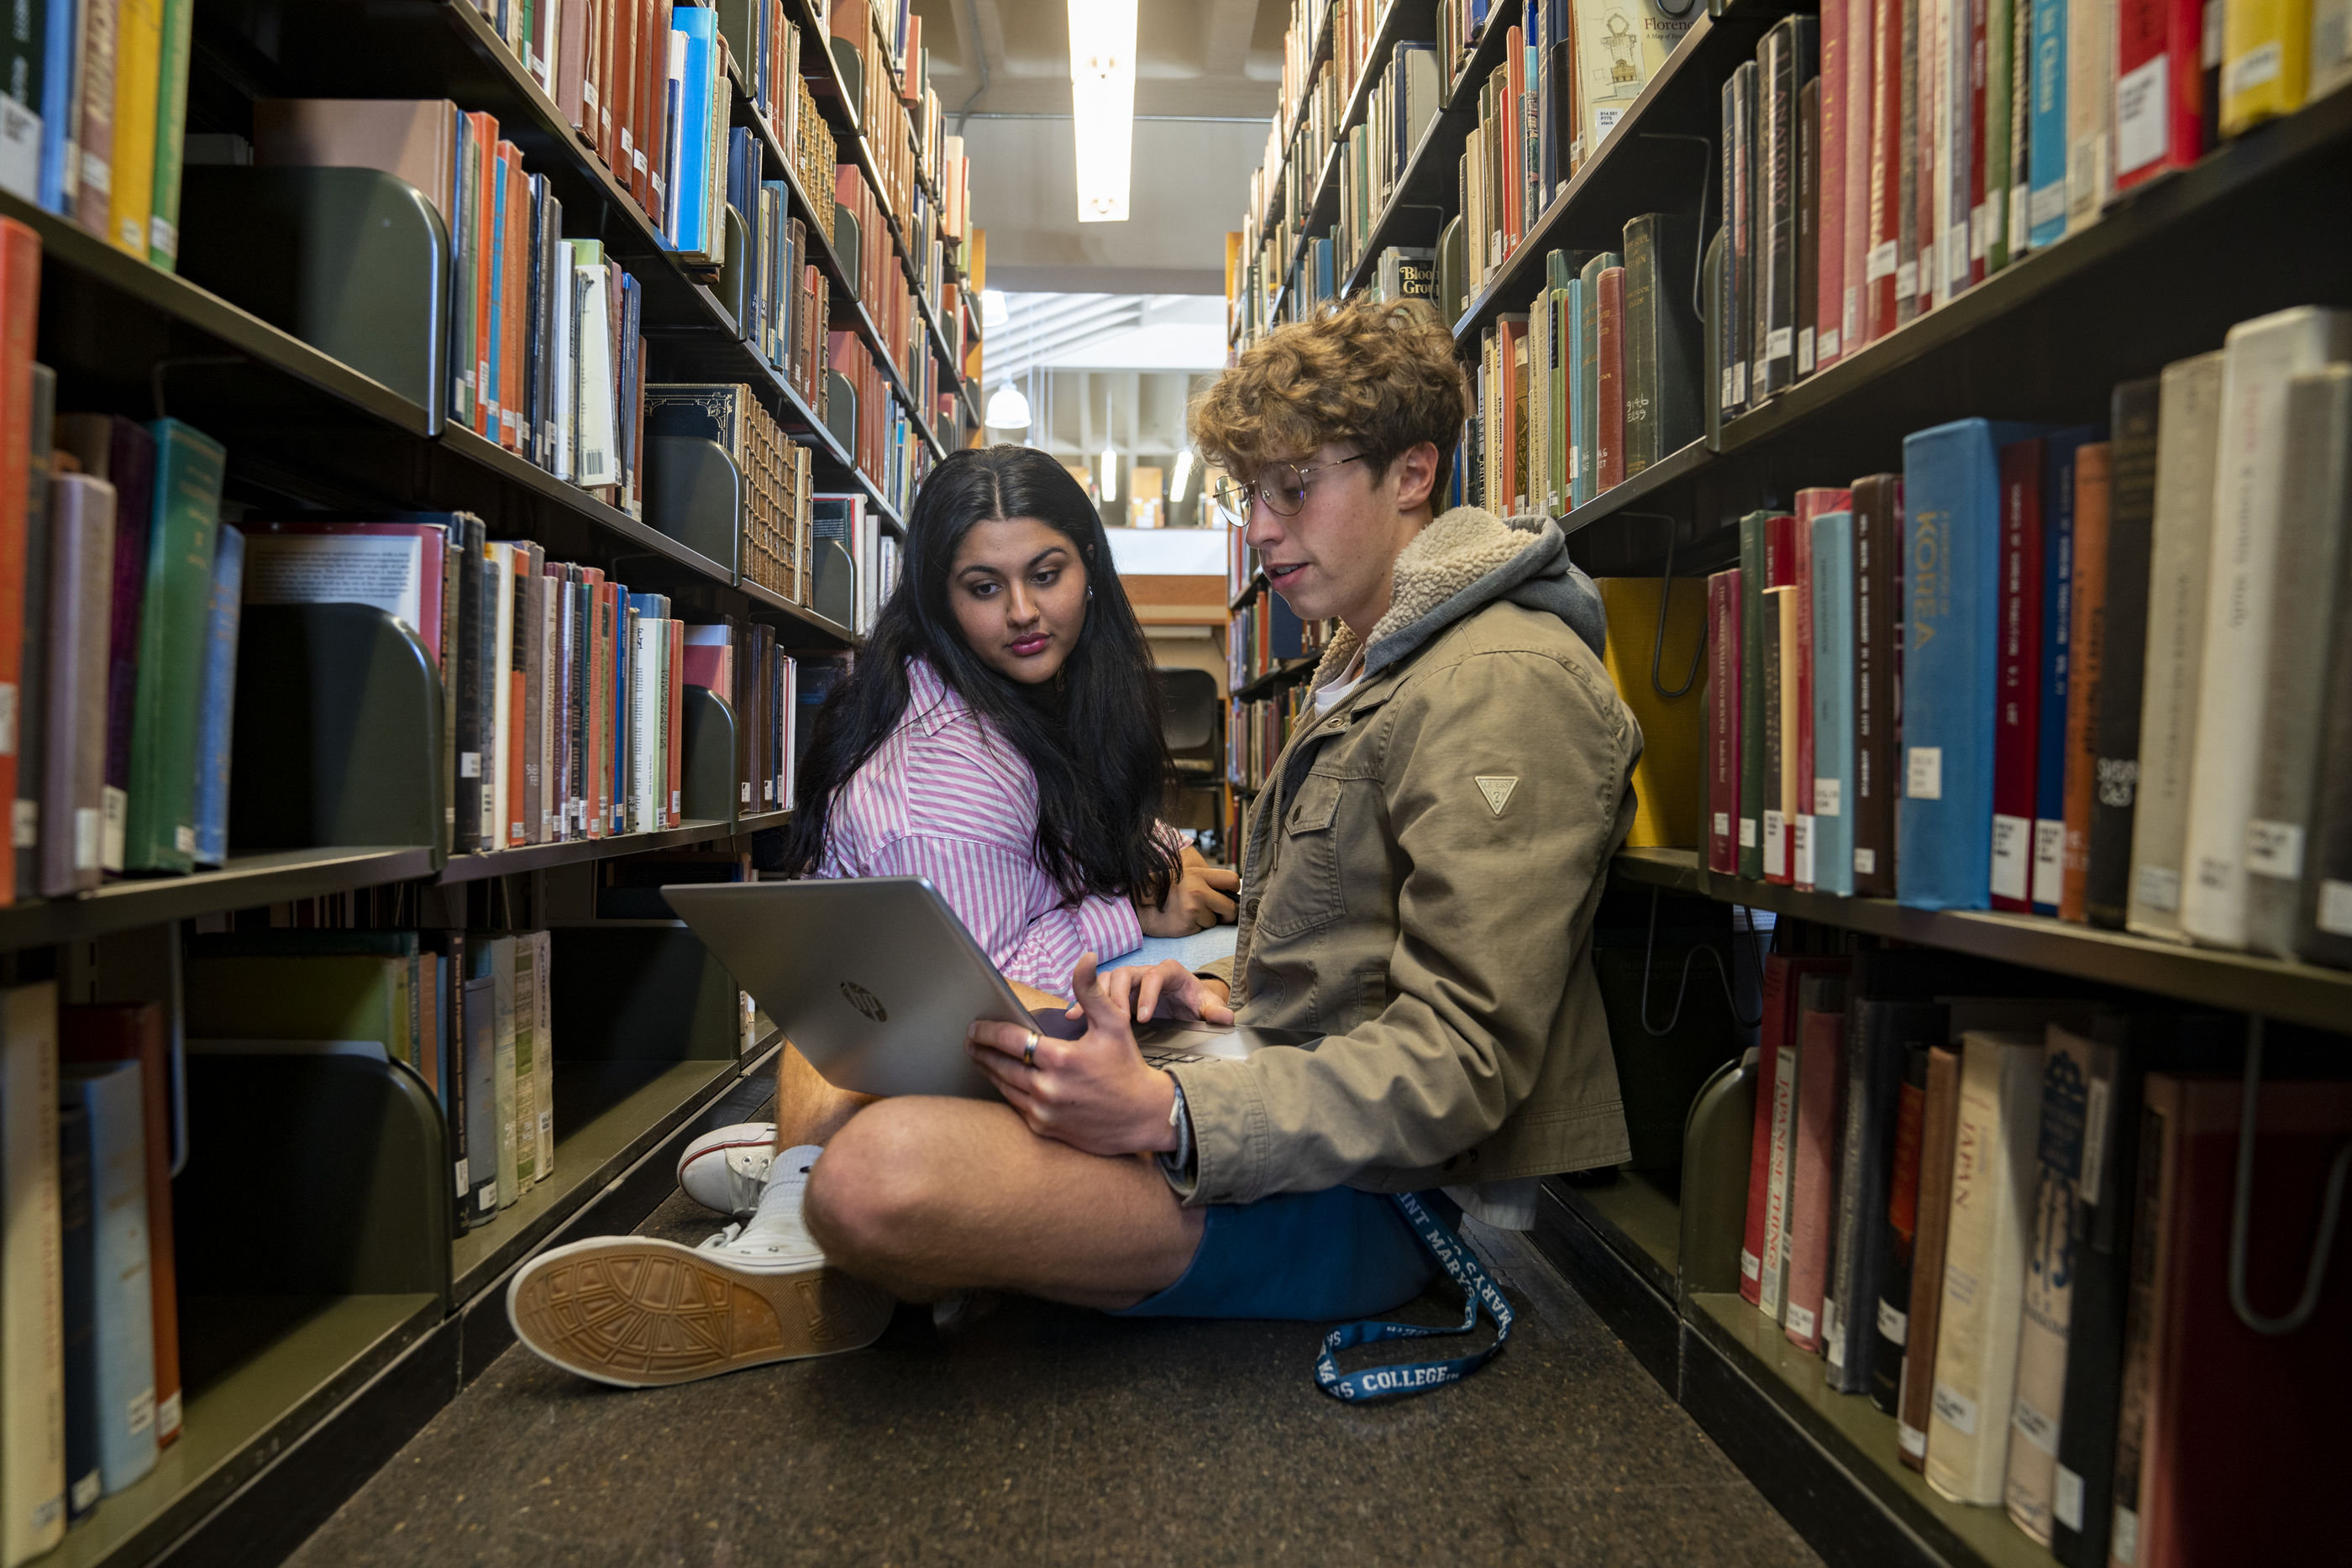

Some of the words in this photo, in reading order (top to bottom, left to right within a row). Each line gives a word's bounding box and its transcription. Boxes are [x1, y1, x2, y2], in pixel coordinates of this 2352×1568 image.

[1770, 89, 1789, 210] ANATOMY
[1718, 585, 1726, 602] THE
[1914, 511, 1938, 651] KOREA
[1718, 644, 1726, 677] VALLEY
[1718, 678, 1726, 698] AND
[572, 705, 581, 732] and
[1718, 699, 1726, 735] BEYOND
[571, 737, 580, 797] Pioneers
[1767, 1075, 1790, 1186] JAPANESE
[1954, 1120, 1977, 1213] JAPAN
[1767, 1190, 1784, 1271] THINGS
[1425, 1229, 1477, 1298] MARYS
[1362, 1366, 1449, 1392] COLLEGE
